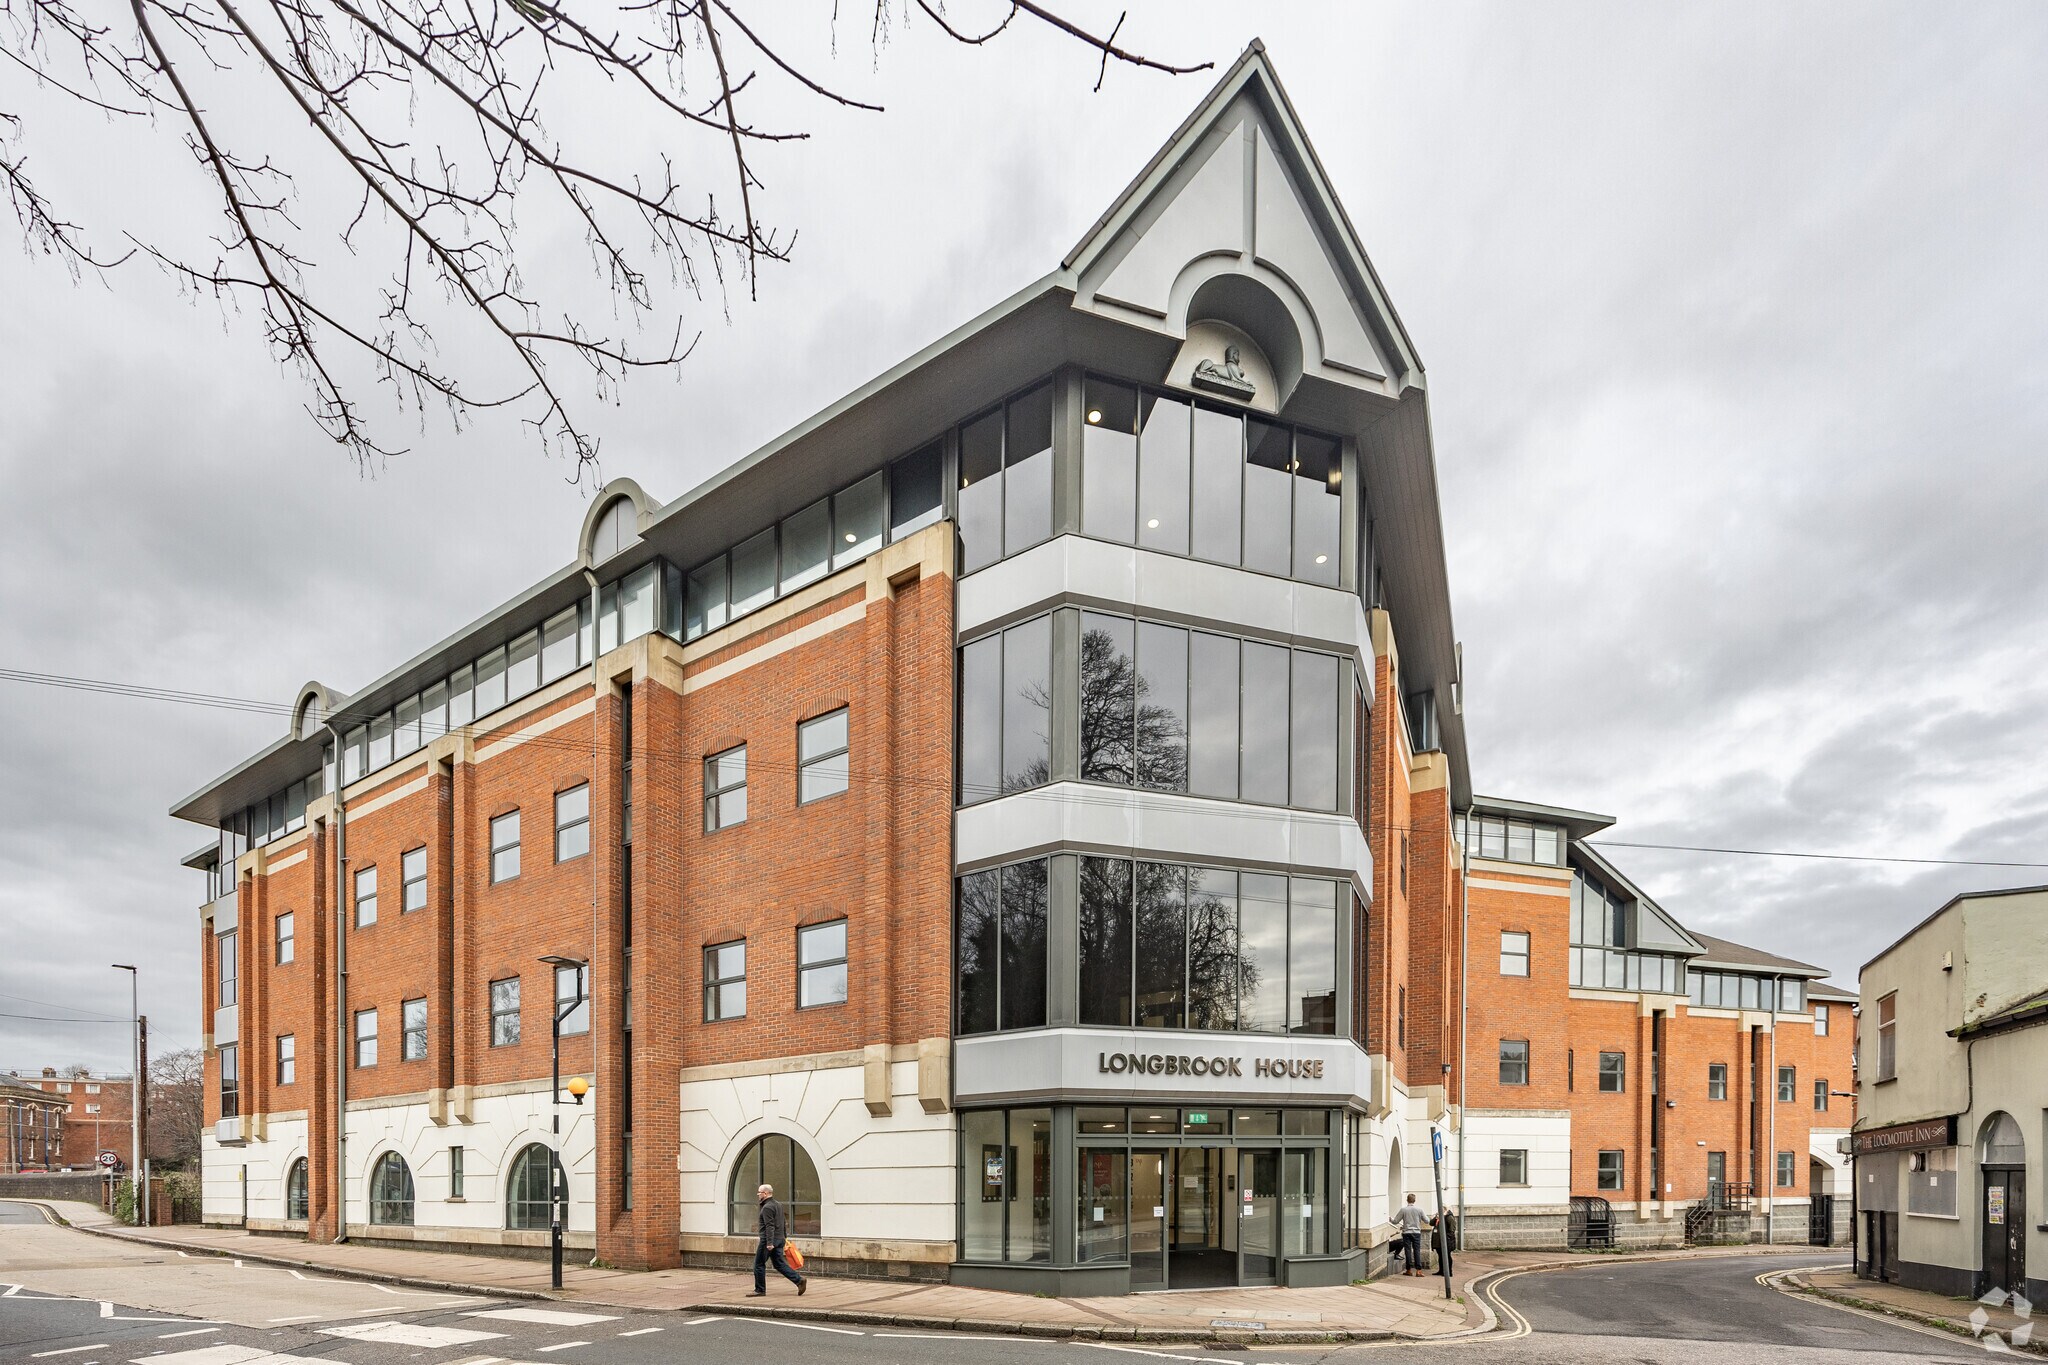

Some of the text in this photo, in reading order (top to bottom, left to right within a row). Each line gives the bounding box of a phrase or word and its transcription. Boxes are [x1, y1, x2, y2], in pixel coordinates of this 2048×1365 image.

[1099, 1052, 1324, 1079] LONGBROOK HOUSE
[1862, 1127, 1931, 1149] THE LOCOMOTIVE INN
